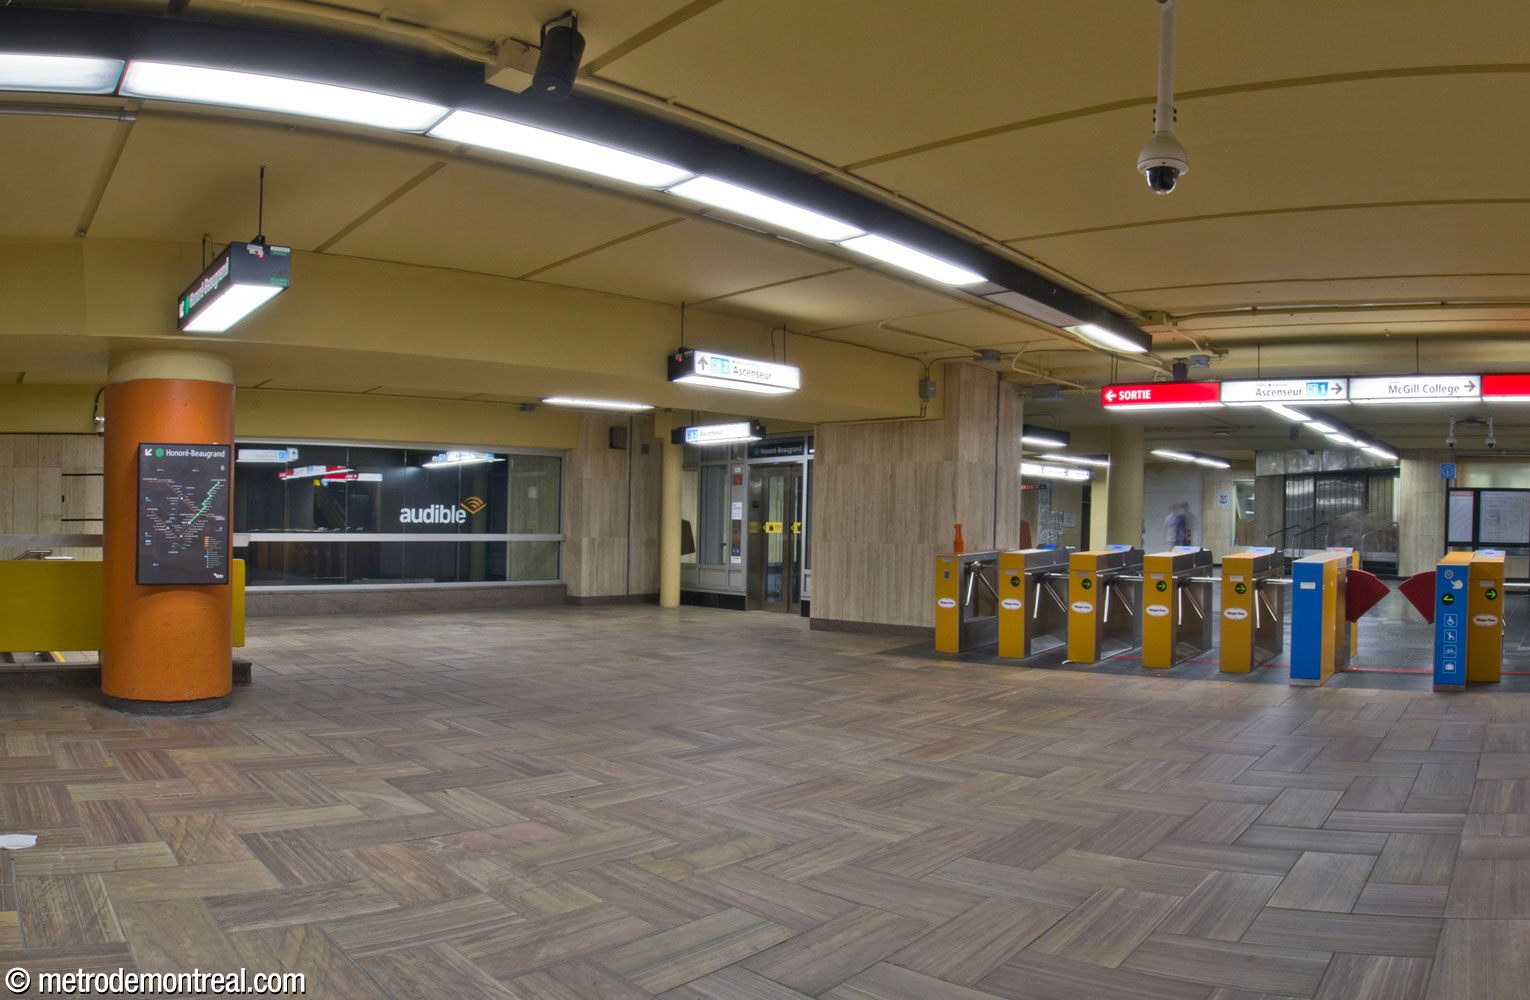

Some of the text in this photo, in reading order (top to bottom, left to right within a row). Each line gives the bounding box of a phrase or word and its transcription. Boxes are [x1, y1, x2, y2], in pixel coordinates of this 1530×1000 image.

[733, 366, 772, 380] Ascenseur
[1255, 388, 1303, 397] Ascenseur
[1388, 384, 1459, 395] McGill College
[1119, 390, 1151, 400] SORTIE
[165, 449, 226, 459] Honoré-Beaugrand
[399, 504, 467, 523] audible
